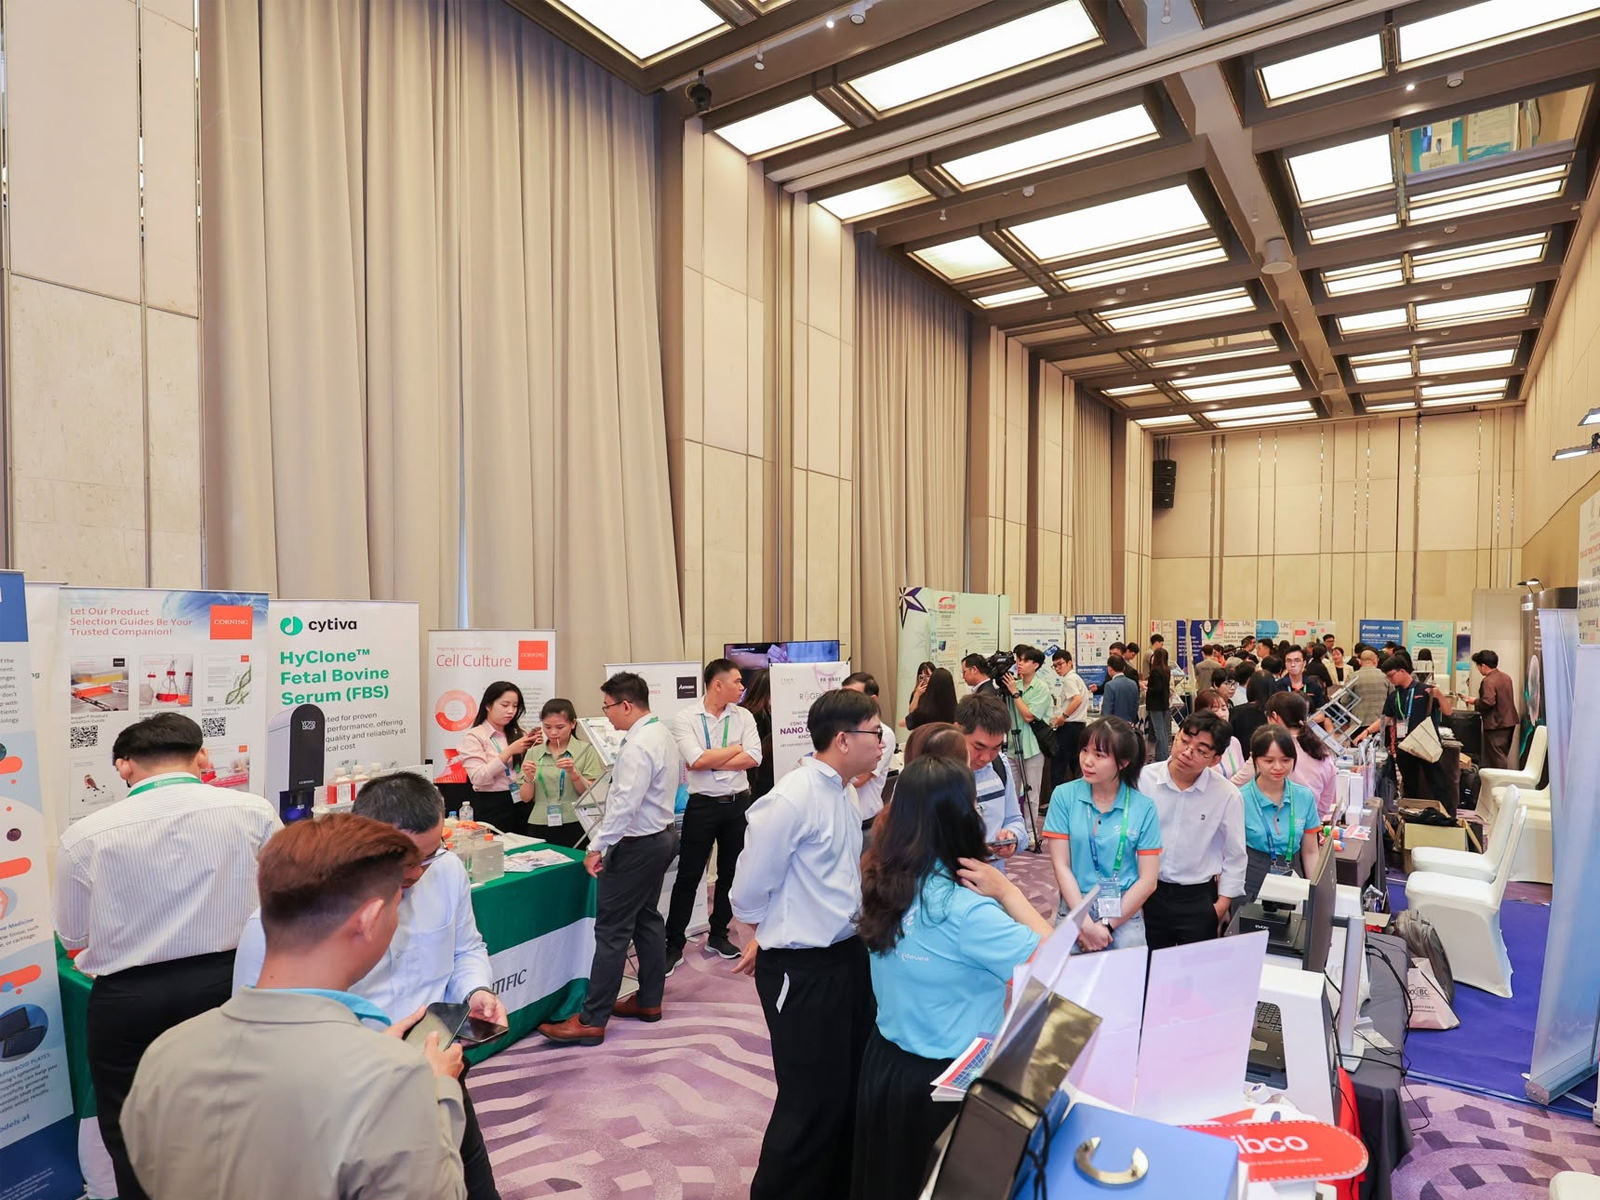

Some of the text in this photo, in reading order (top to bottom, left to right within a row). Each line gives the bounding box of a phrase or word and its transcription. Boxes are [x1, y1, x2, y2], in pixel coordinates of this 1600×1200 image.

[70, 607, 149, 616] Let Our Product
[70, 617, 193, 627] Selection Guides Be Your
[308, 618, 358, 633] cytiva
[70, 628, 172, 637] Trusted Companion!
[280, 649, 370, 668] HyClone™
[436, 654, 512, 667] Cell Culture
[280, 668, 389, 685] Fetal Bovine
[281, 685, 389, 705] Serum (FBS)
[341, 714, 352, 722] for
[353, 712, 378, 723] proven
[377, 719, 403, 729] offering
[325, 734, 351, 744] quality
[352, 732, 366, 740] and
[367, 729, 398, 739] reliability
[780, 727, 804, 735] NANO
[326, 743, 356, 753] ical cost
[492, 969, 527, 994] TIFIC
[1230, 1134, 1309, 1154] ibco
